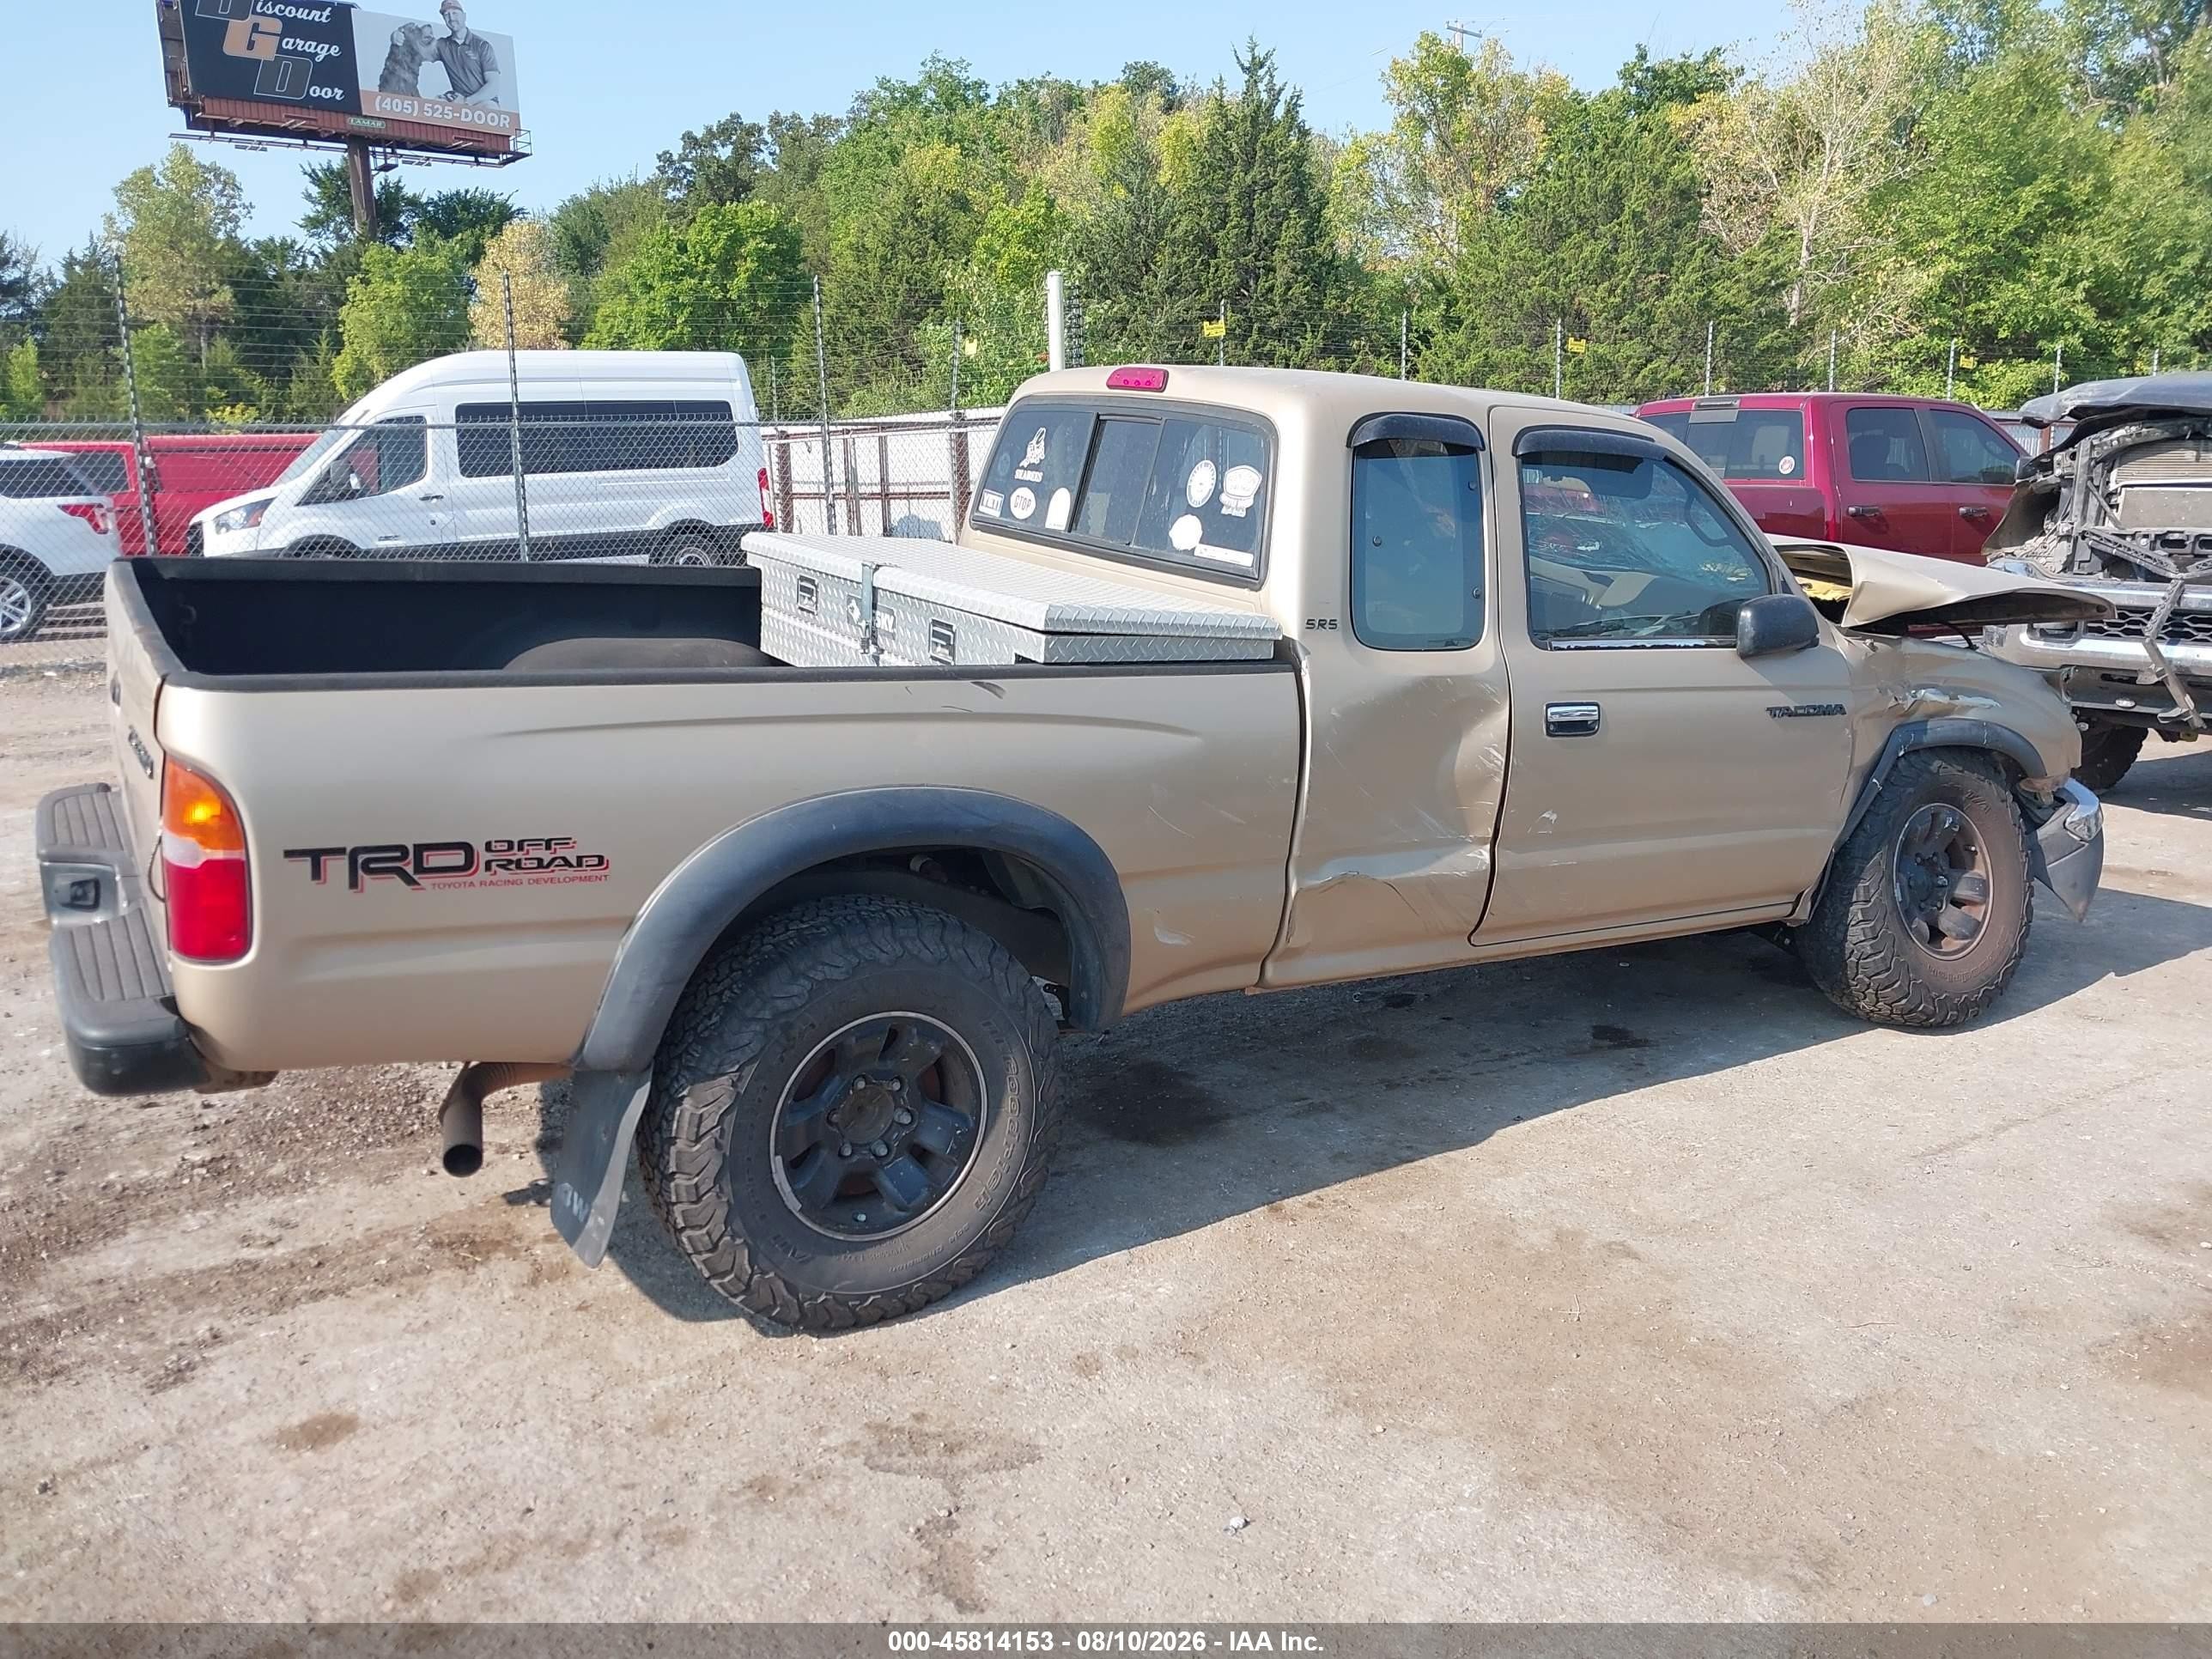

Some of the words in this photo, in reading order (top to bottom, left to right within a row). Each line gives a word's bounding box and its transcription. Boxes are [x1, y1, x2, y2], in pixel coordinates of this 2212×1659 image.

[223, 15, 342, 62] Garage
[254, 54, 345, 100] Door
[374, 95, 419, 117] (405)
[423, 103, 511, 129] 525-DOOR
[1765, 703, 1847, 718] TACOMA
[484, 836, 577, 857] OFF
[283, 841, 480, 894] TRD
[484, 854, 610, 876] ROAD
[431, 879, 477, 890] TOYOTA
[479, 877, 525, 888] RACING
[527, 874, 611, 886] DEVELOPMENT
